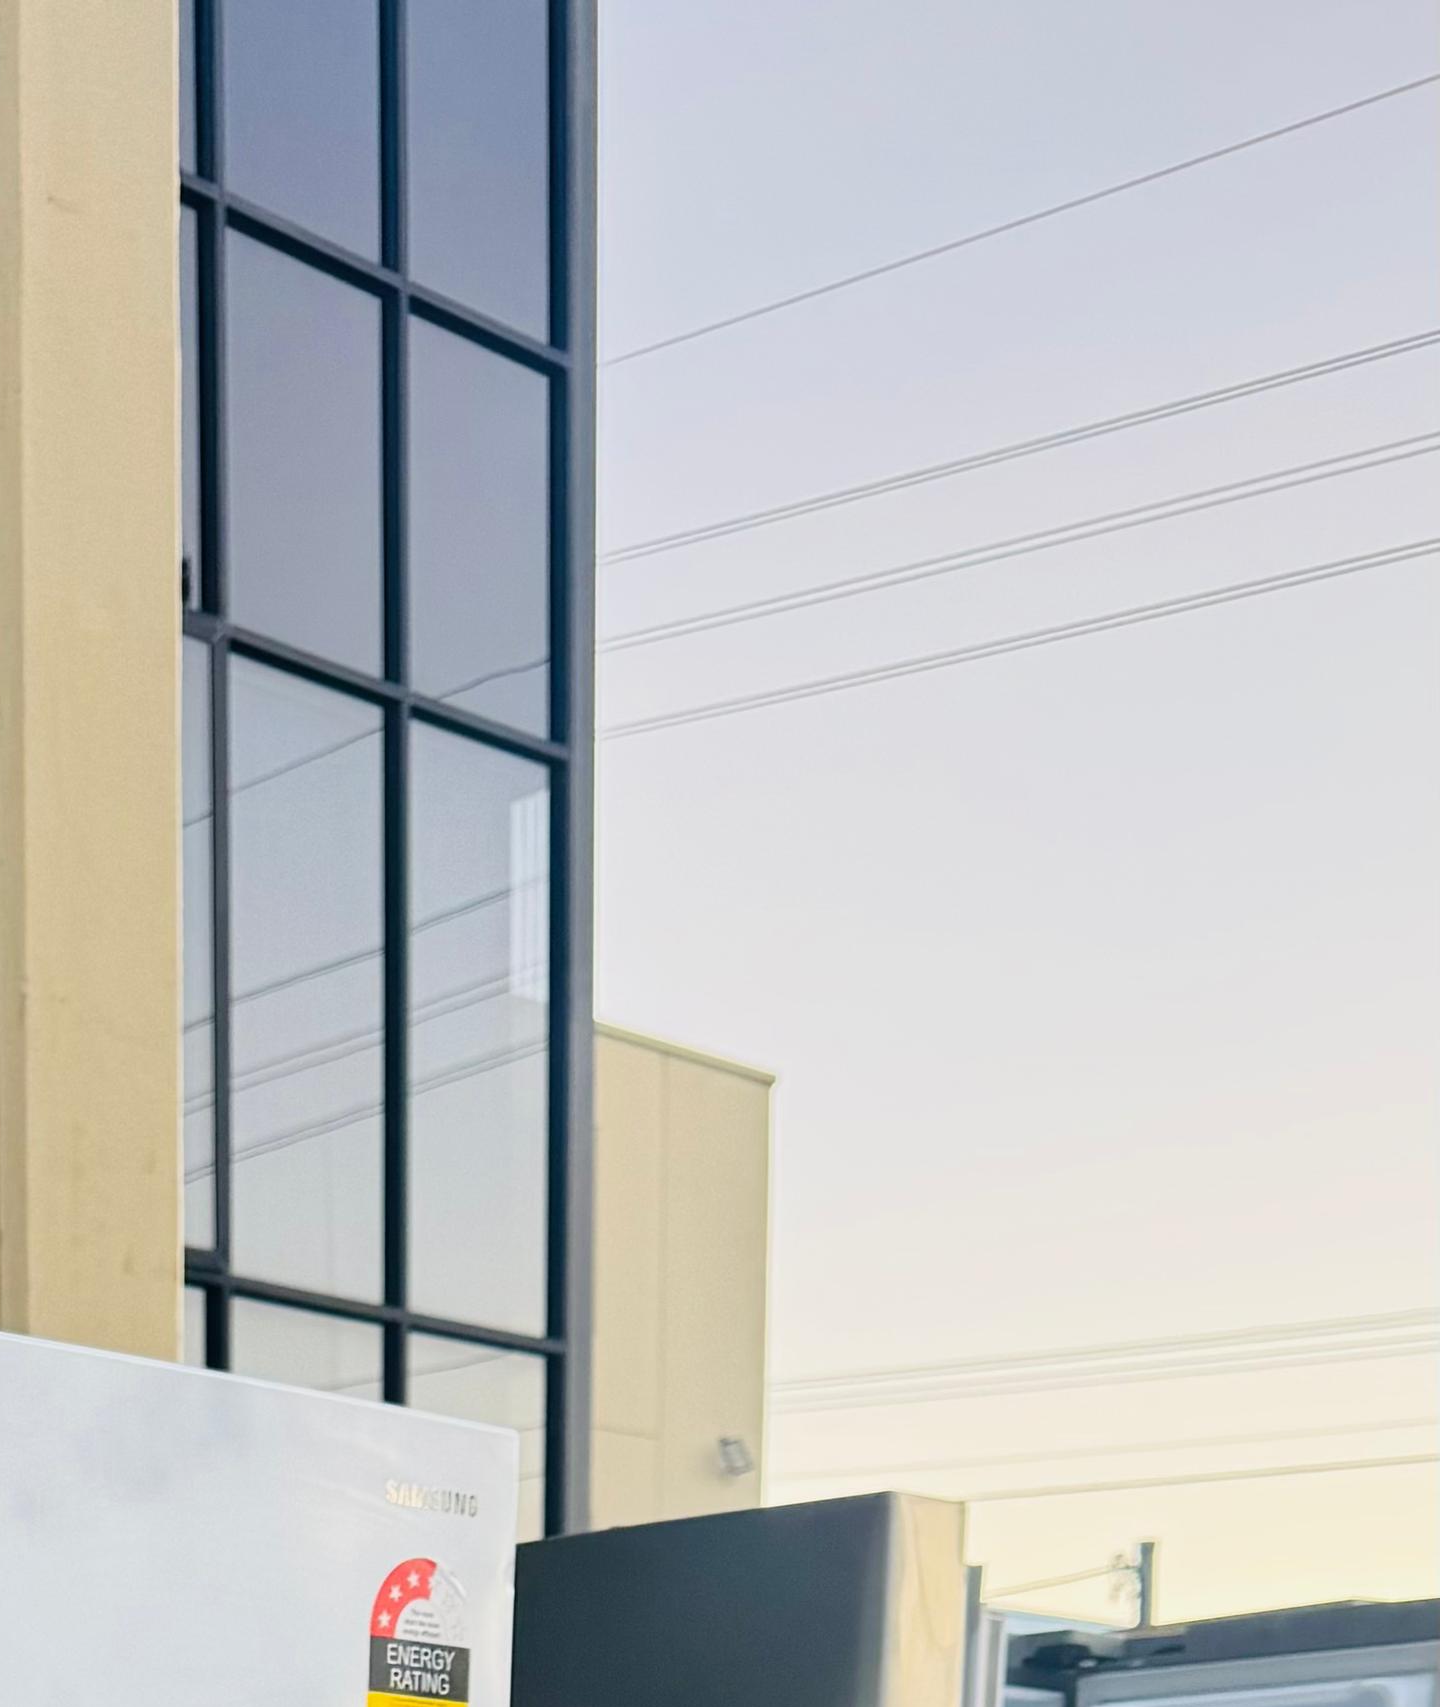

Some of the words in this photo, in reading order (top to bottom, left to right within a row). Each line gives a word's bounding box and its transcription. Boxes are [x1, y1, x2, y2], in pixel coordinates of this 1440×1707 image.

[385, 1480, 478, 1518] SAMSUNG
[387, 1643, 456, 1672] ENERGY
[389, 1667, 450, 1695] RATING
